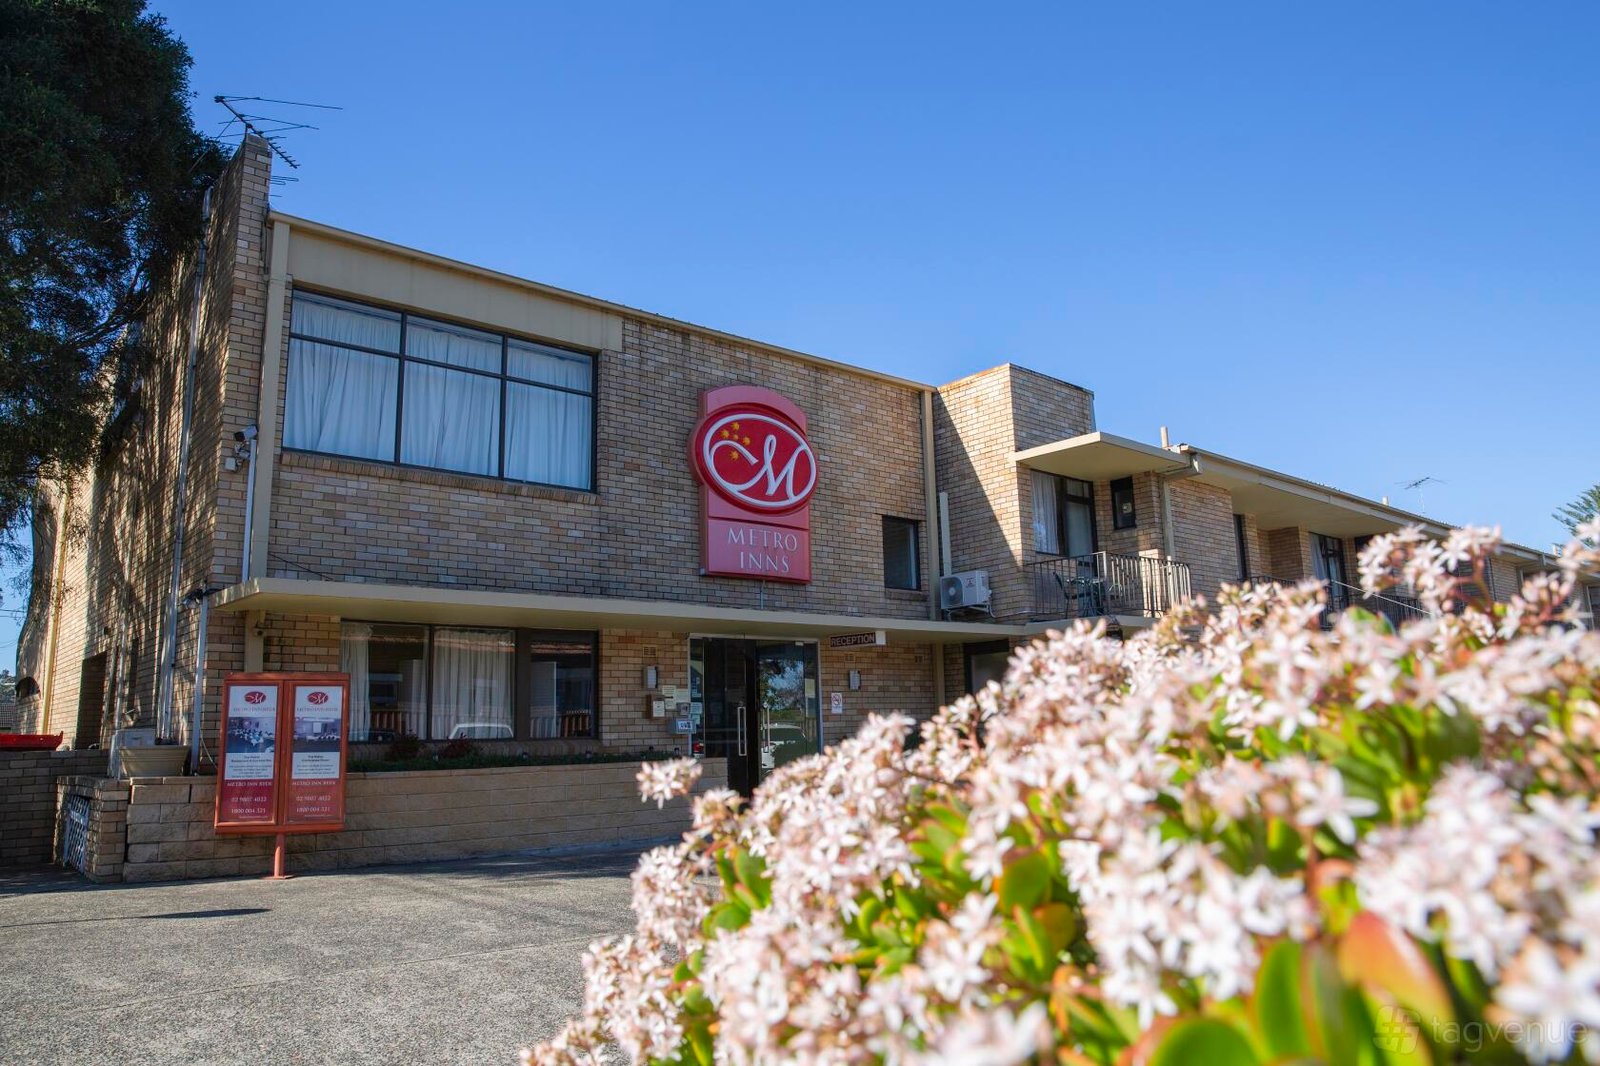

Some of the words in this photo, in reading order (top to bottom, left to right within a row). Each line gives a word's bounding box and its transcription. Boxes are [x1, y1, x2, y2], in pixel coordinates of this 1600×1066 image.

[727, 527, 798, 552] METRO
[739, 551, 790, 573] INNS
[831, 634, 874, 647] RECEPTION
